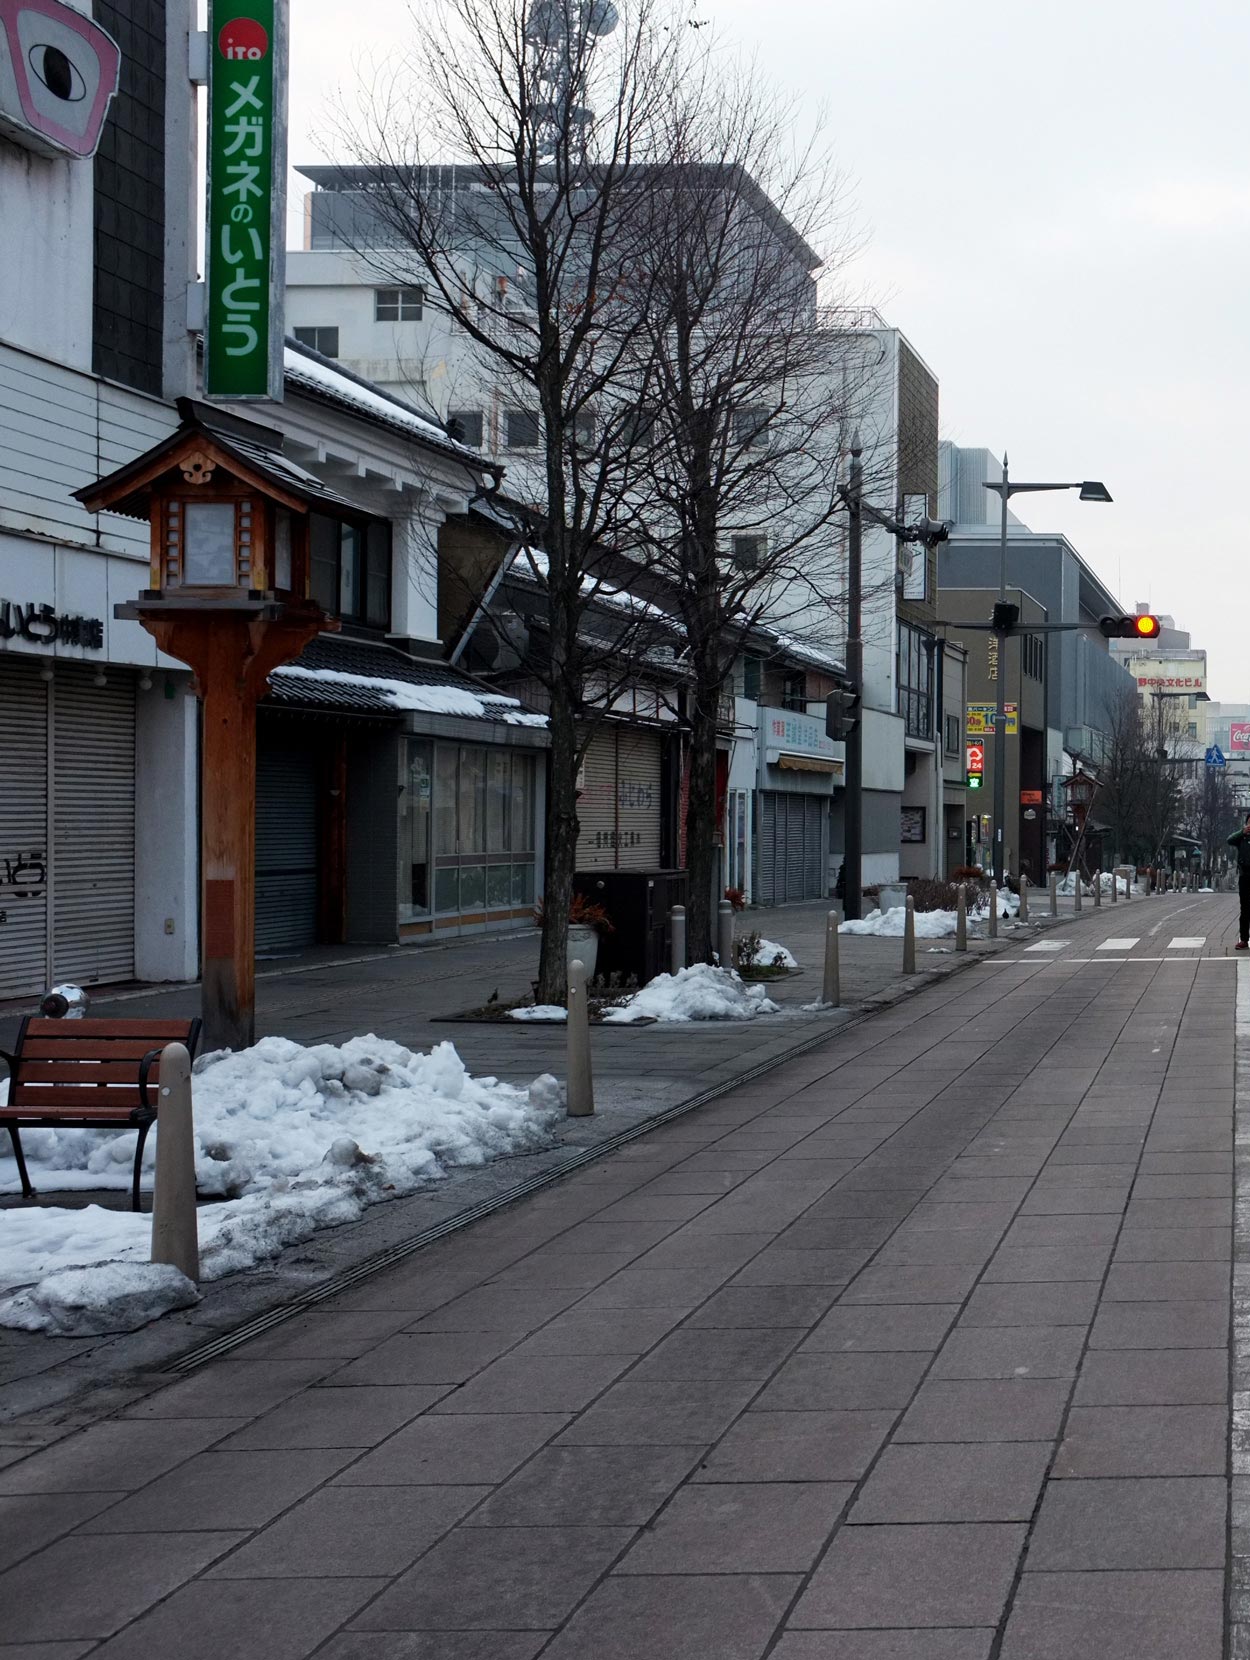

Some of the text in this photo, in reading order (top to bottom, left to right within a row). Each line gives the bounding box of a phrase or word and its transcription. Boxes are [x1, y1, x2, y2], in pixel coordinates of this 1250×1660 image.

[221, 75, 264, 357] メガネのいとう
[0, 598, 57, 645] いとう
